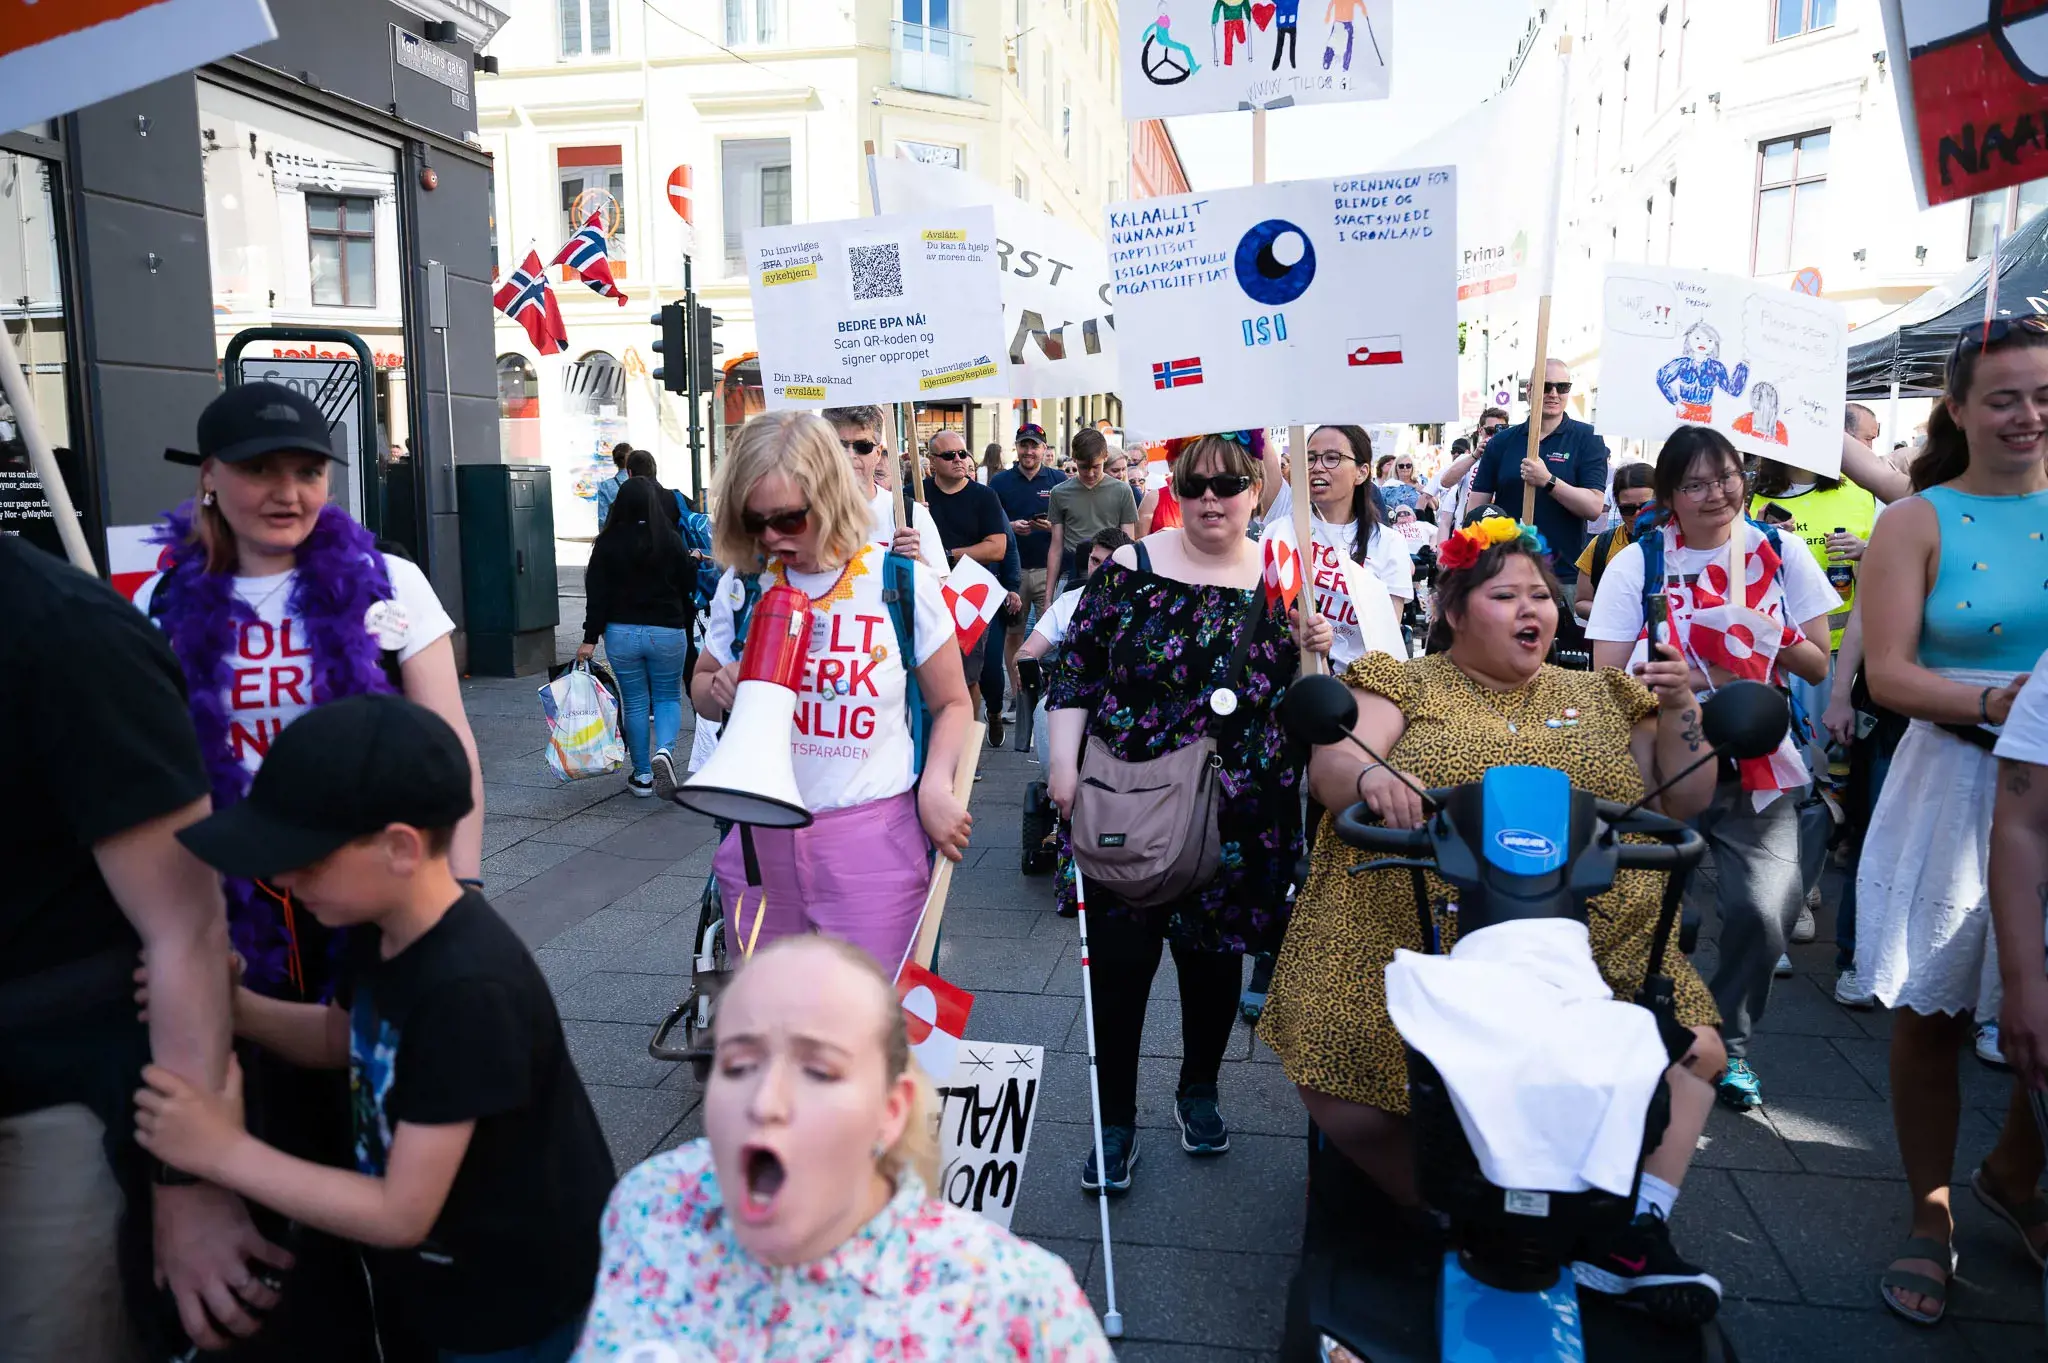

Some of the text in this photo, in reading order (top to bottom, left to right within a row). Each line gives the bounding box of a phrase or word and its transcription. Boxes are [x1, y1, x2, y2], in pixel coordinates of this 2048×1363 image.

[401, 35, 417, 55] Karl
[420, 46, 445, 68] Johans
[447, 61, 463, 77] gate
[1428, 171, 1449, 185] FOR
[1335, 194, 1412, 209] BLINDE OG
[1110, 200, 1209, 228] KALAALLIT
[1112, 221, 1196, 244] NUNAANNI
[1339, 226, 1433, 241] I GRØNLAND
[760, 242, 819, 257] Du innvilges
[927, 241, 938, 249] Du
[940, 241, 956, 249] kan
[968, 242, 990, 252] hjelp
[785, 256, 809, 268] plass
[811, 251, 823, 264] på
[1464, 245, 1505, 264] Prima
[765, 269, 813, 284] sykehjem.
[838, 312, 926, 332] BEDRE BPA NÅ!
[1242, 313, 1287, 347] ISI
[834, 332, 934, 349] Scan QR-koden og
[842, 348, 929, 367] signer oppropet
[921, 369, 933, 377] Du
[935, 361, 972, 374] innvilges
[774, 373, 852, 385] Din BPA søknad
[26, 470, 39, 478] inst
[16, 501, 31, 509] page
[4, 510, 17, 518] Nor
